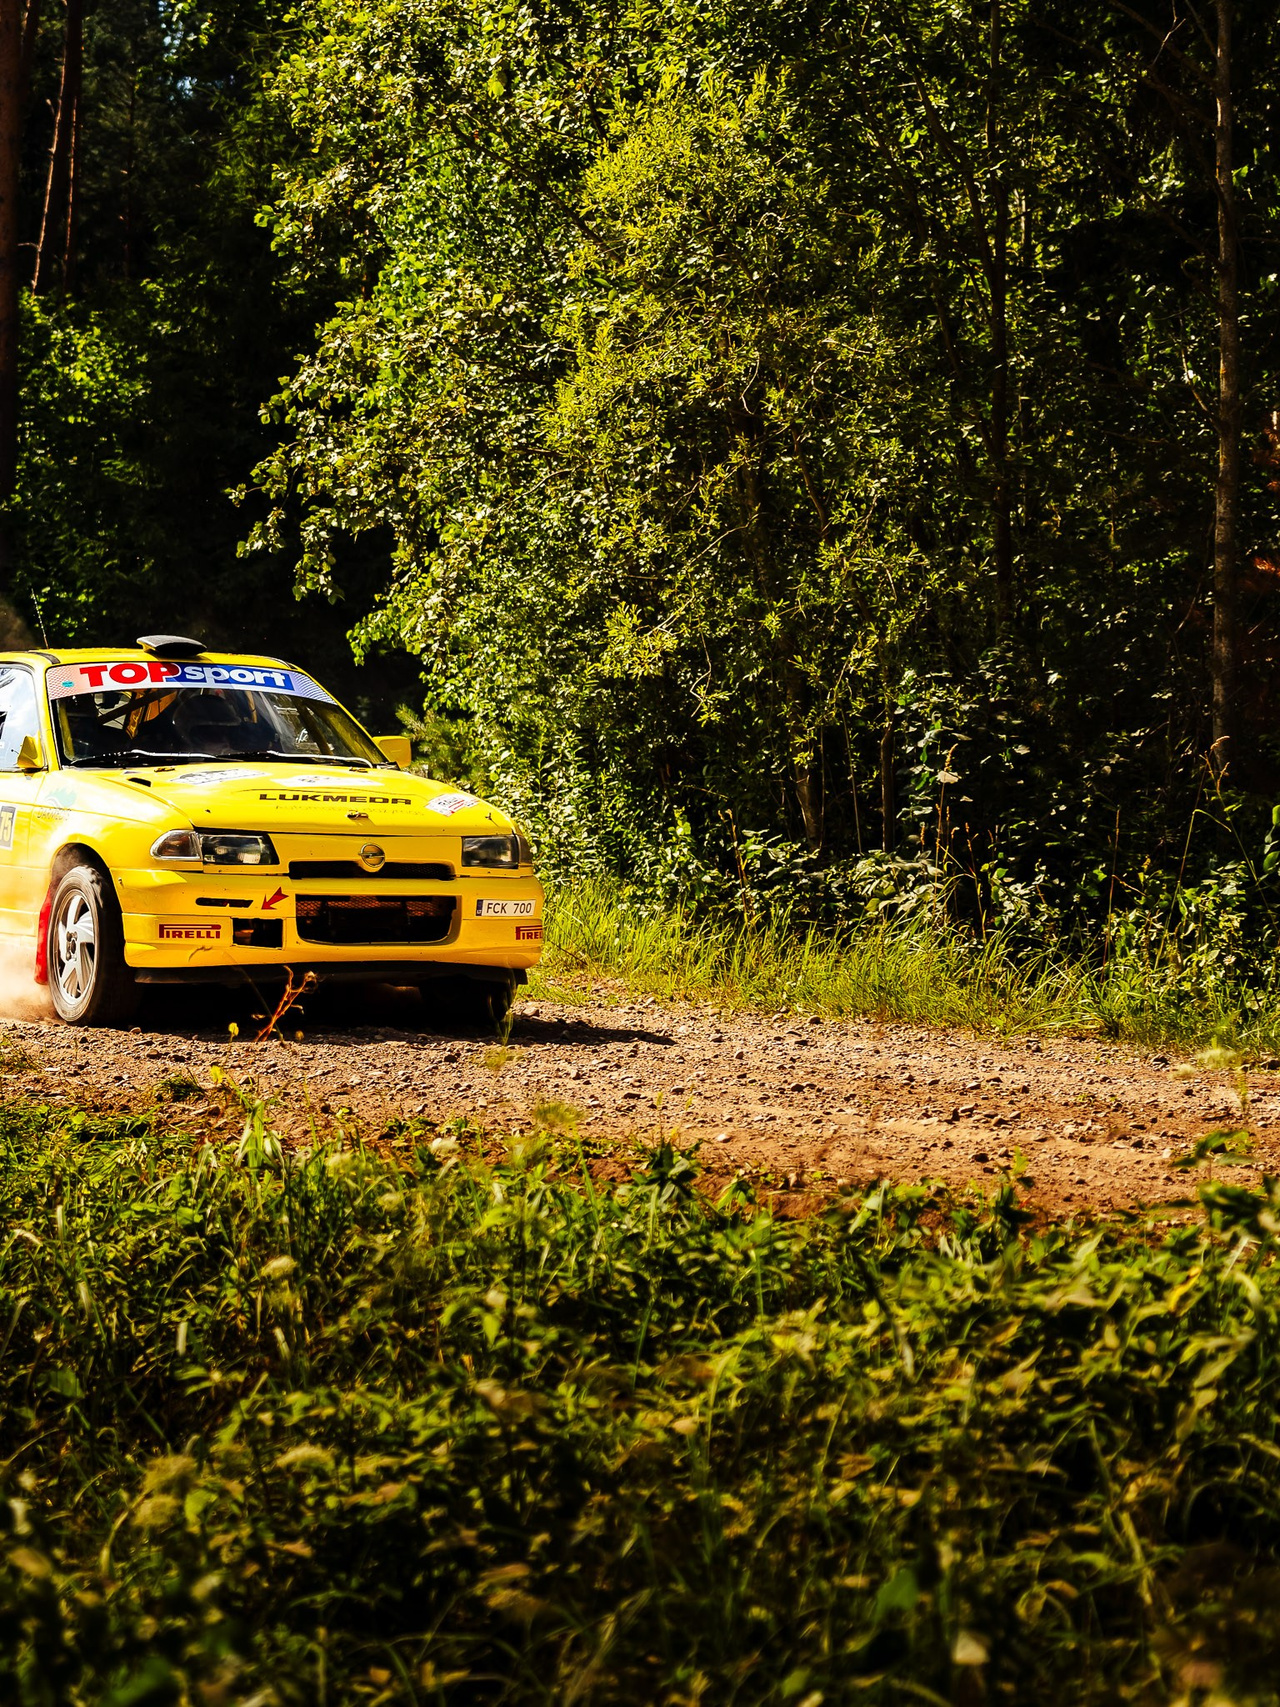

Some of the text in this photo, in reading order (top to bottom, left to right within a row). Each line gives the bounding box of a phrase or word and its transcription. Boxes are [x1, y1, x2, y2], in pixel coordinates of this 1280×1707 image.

[259, 793, 412, 806] LUKMEDA
[486, 902, 532, 914] FCK 700
[158, 923, 222, 939] PIRELLI
